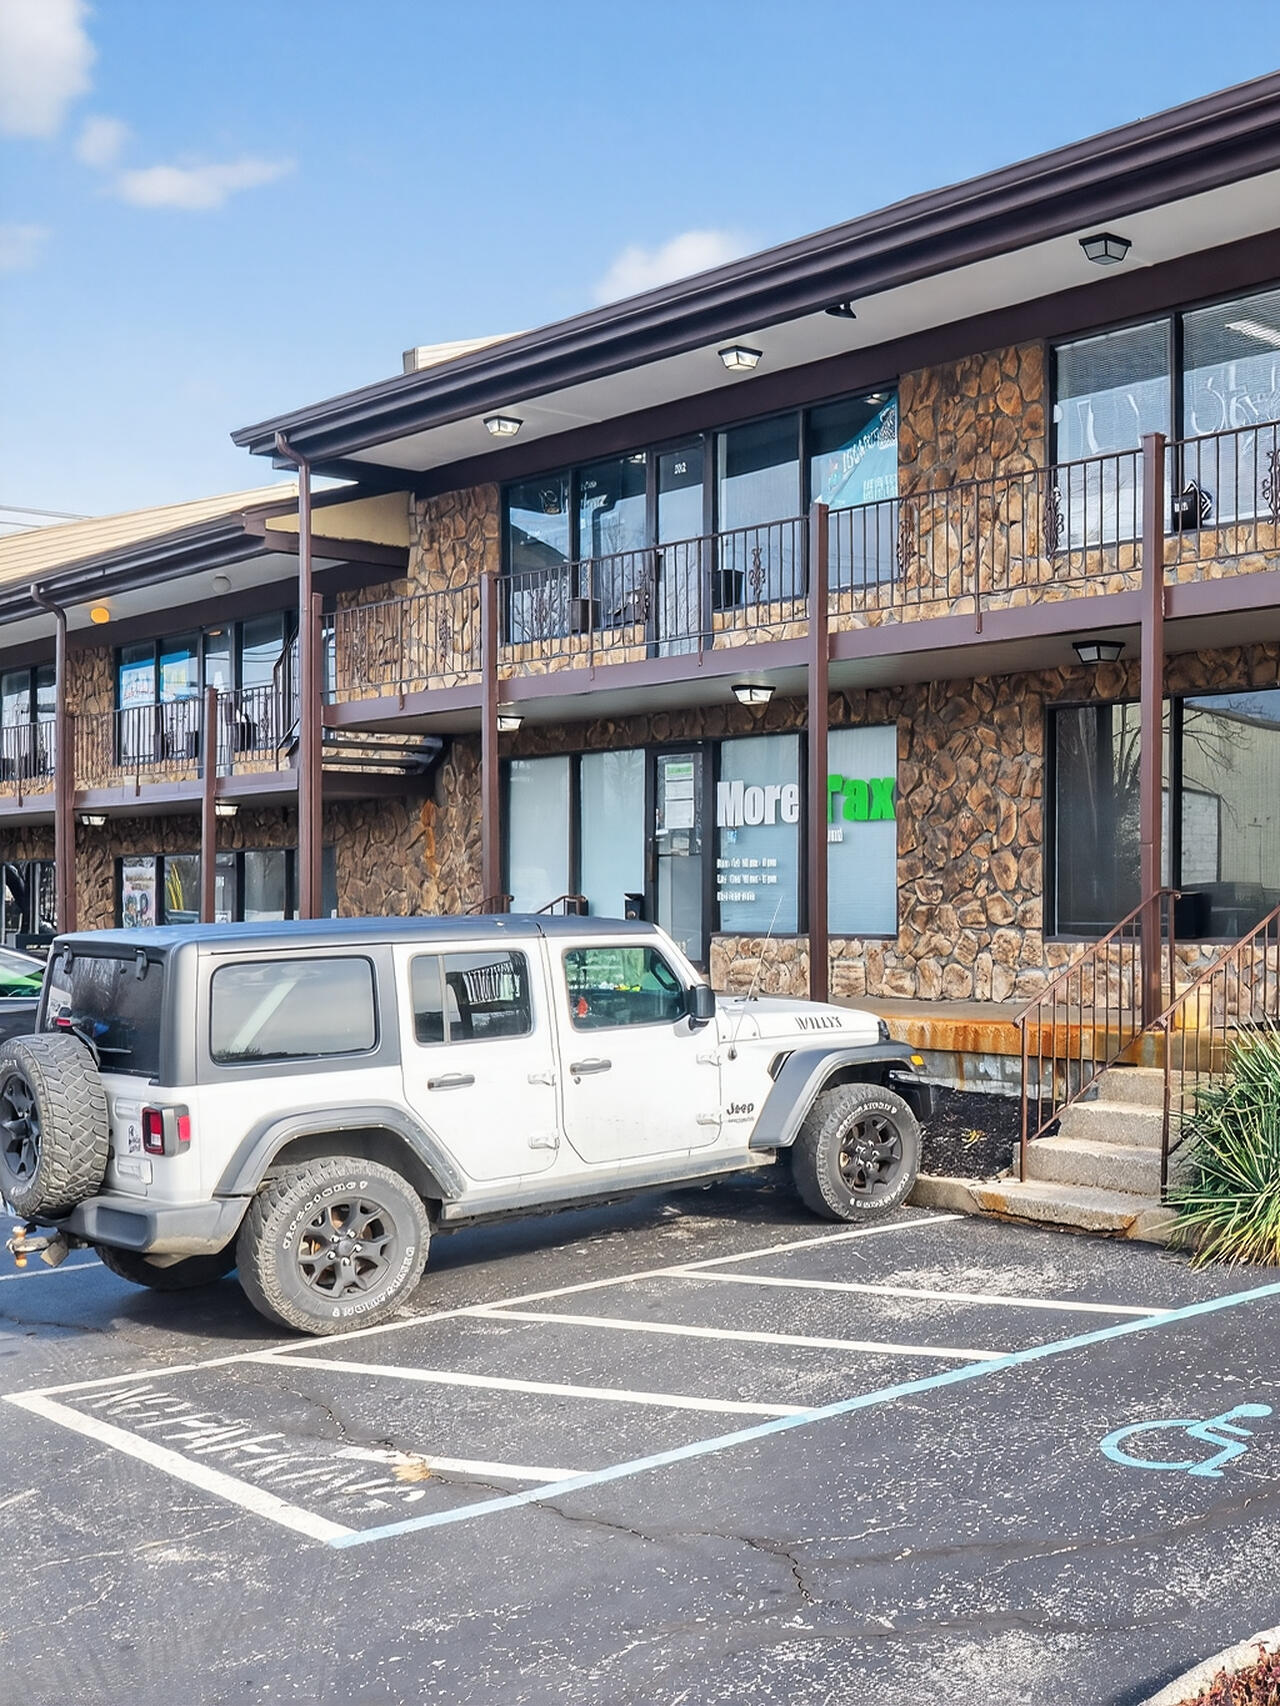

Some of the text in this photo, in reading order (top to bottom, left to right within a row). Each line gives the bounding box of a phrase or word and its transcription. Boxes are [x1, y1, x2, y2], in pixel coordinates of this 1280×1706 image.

[717, 779, 799, 827] More
[795, 1016, 843, 1030] WILLYS
[726, 1102, 755, 1115] Jeep
